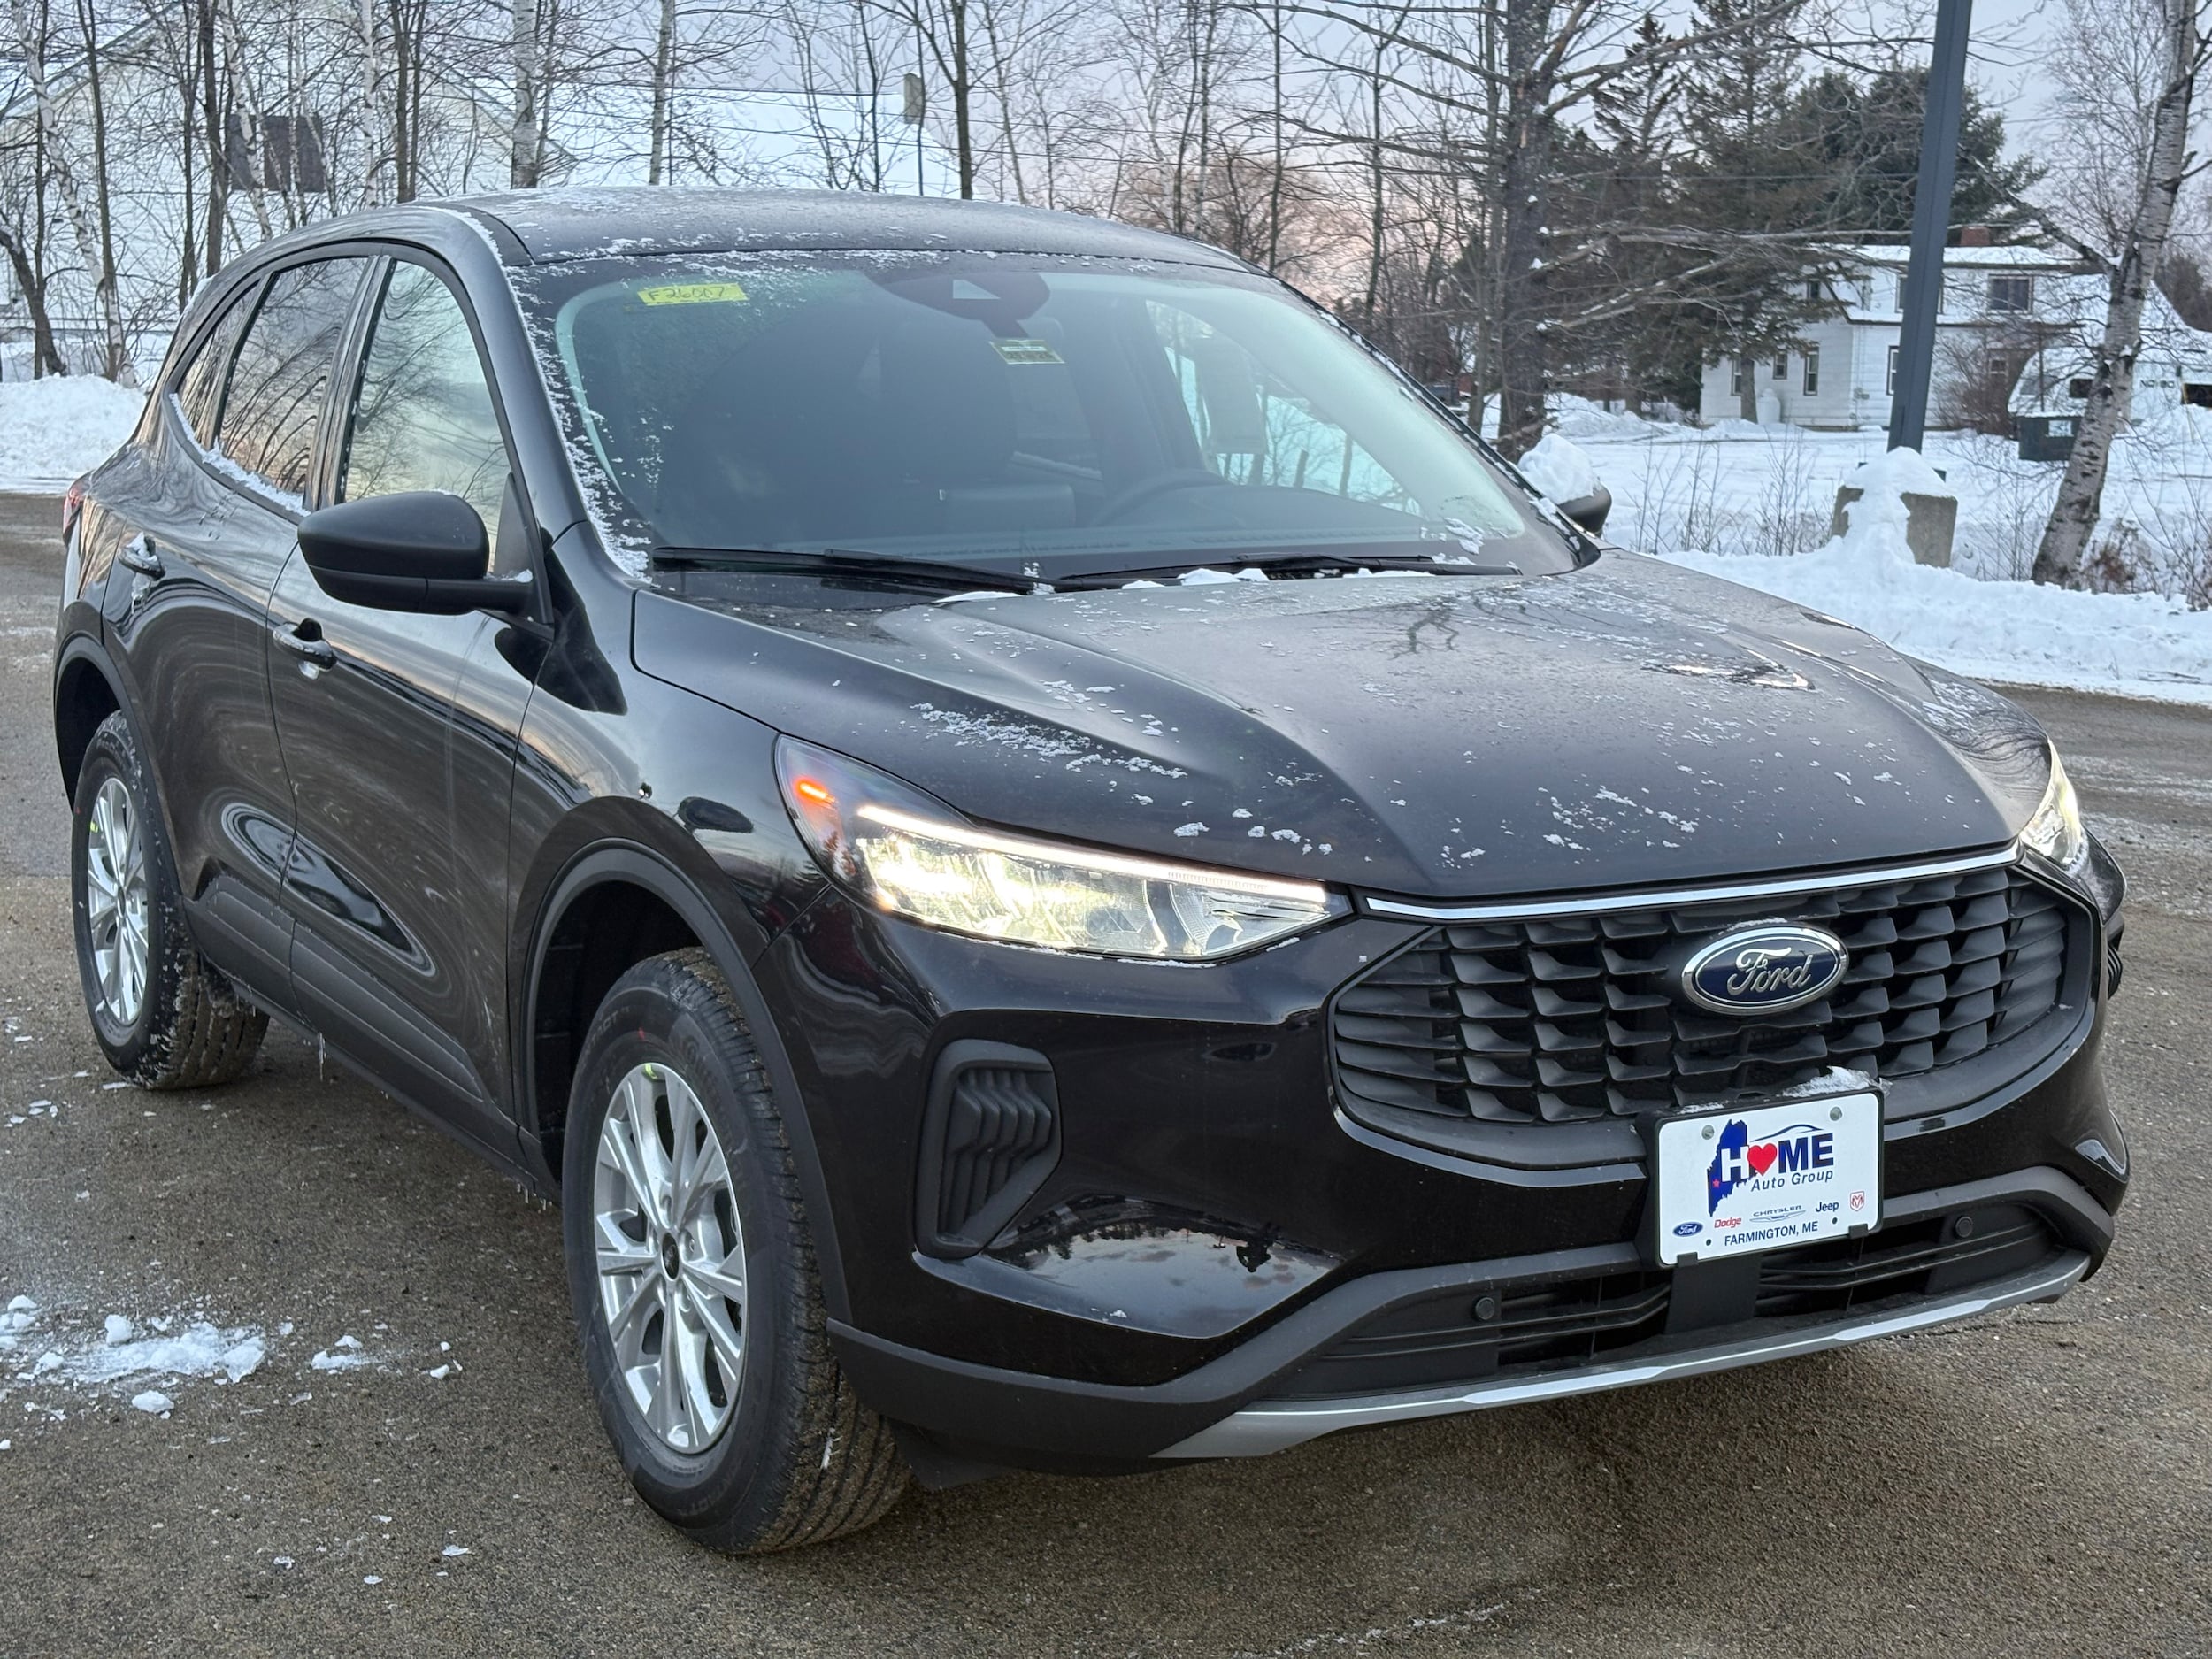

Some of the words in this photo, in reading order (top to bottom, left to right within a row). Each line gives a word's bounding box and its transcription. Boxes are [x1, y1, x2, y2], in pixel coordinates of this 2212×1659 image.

[1726, 946, 1814, 995] Ford
[1750, 1177, 1786, 1193] Auto
[1791, 1170, 1834, 1186] Group
[1752, 1204, 1802, 1217] CHRYSLER
[1815, 1201, 1839, 1213] Jeep
[1713, 1217, 1742, 1229] Dodge
[1724, 1224, 1800, 1247] FARMINGTON,
[1801, 1220, 1819, 1233] ME
